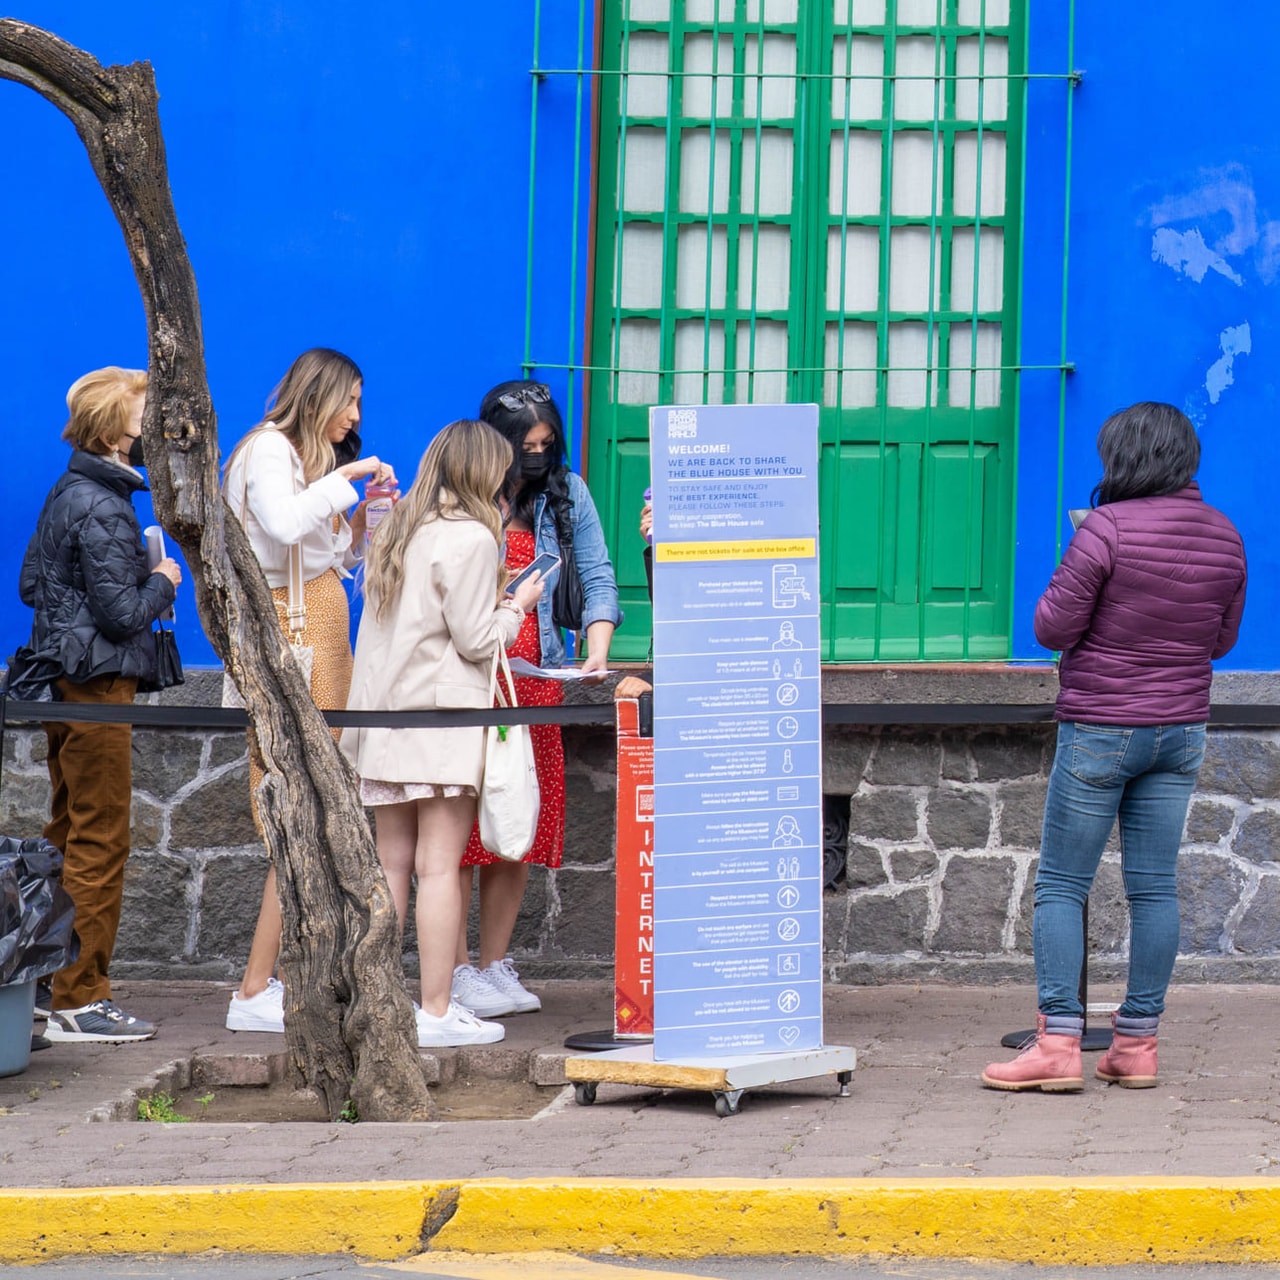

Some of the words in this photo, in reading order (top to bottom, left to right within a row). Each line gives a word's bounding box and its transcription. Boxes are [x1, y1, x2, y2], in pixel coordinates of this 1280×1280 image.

[668, 444, 730, 455] WELCOME!
[668, 459, 685, 467] WE
[687, 458, 706, 466] ARE
[709, 457, 735, 466] BACK
[739, 457, 751, 465] TO
[754, 456, 787, 465] SHARE
[668, 470, 686, 478] THE
[690, 469, 714, 478] BLUE
[718, 468, 751, 477] HOUSE
[754, 467, 779, 476] WITH
[783, 466, 803, 475] YOU
[699, 502, 731, 510] FOLLOW
[697, 520, 709, 528] The
[727, 519, 748, 527] House
[638, 829, 654, 996] INTERNET
